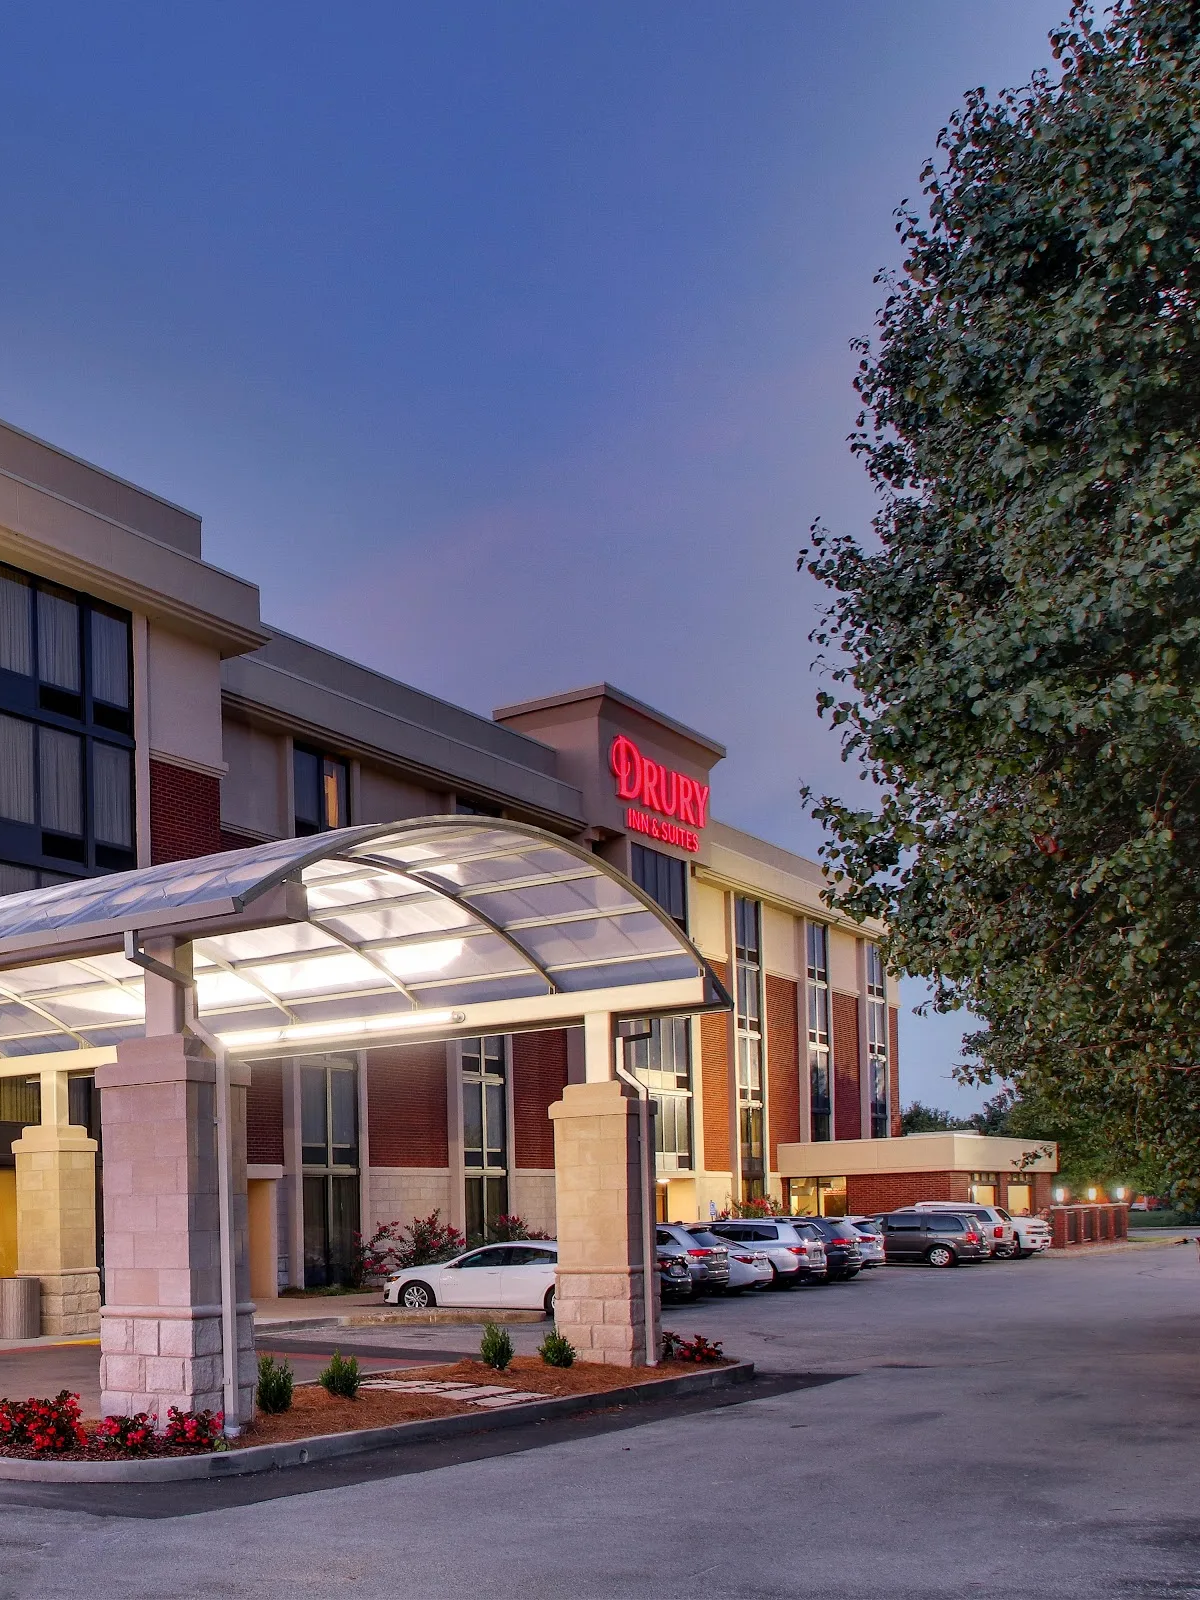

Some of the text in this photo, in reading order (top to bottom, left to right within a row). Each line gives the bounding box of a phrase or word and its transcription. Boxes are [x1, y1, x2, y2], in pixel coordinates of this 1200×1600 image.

[611, 735, 710, 829] DRURY
[627, 807, 700, 853] INN & SUITES
